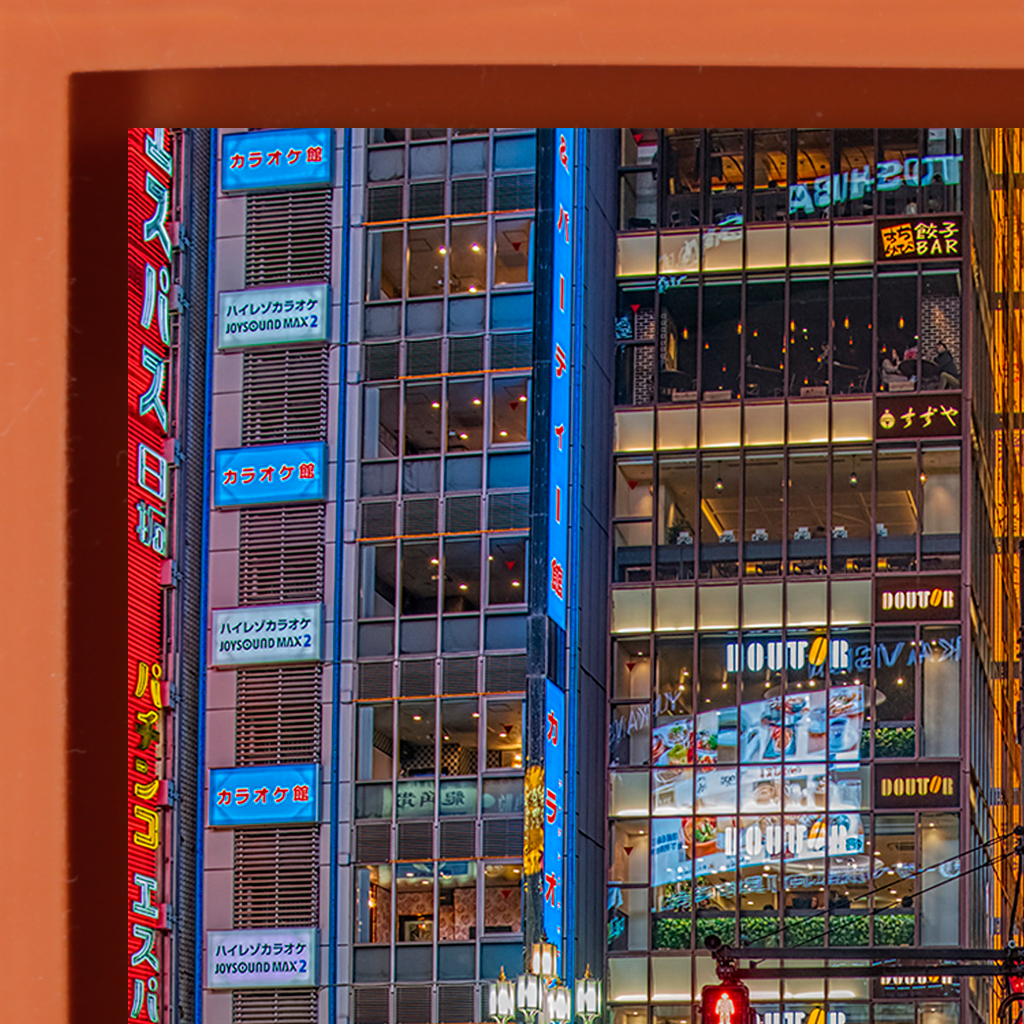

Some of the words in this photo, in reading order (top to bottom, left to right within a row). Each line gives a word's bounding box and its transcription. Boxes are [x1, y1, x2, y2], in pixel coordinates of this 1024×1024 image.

[229, 146, 323, 170] カラオケ館
[913, 221, 959, 240] 餃子
[915, 239, 958, 256] BAR
[225, 298, 319, 317] ハイレゾカラオケ
[225, 318, 282, 335] JOYSOUND
[900, 403, 959, 429] すずや
[222, 462, 316, 486] カラオケ館
[881, 588, 955, 611] DOUTOR
[219, 618, 312, 636] ハイレゾカラオケ
[218, 636, 275, 652] JOYSOUND
[725, 636, 850, 673] DOUTOR
[133, 661, 162, 850] パチンコ
[216, 785, 310, 806] カラオケ館
[881, 774, 954, 797] DOUTOR
[214, 943, 307, 958] ハイレゾカラオケ
[214, 960, 271, 976] JOYSOUND
